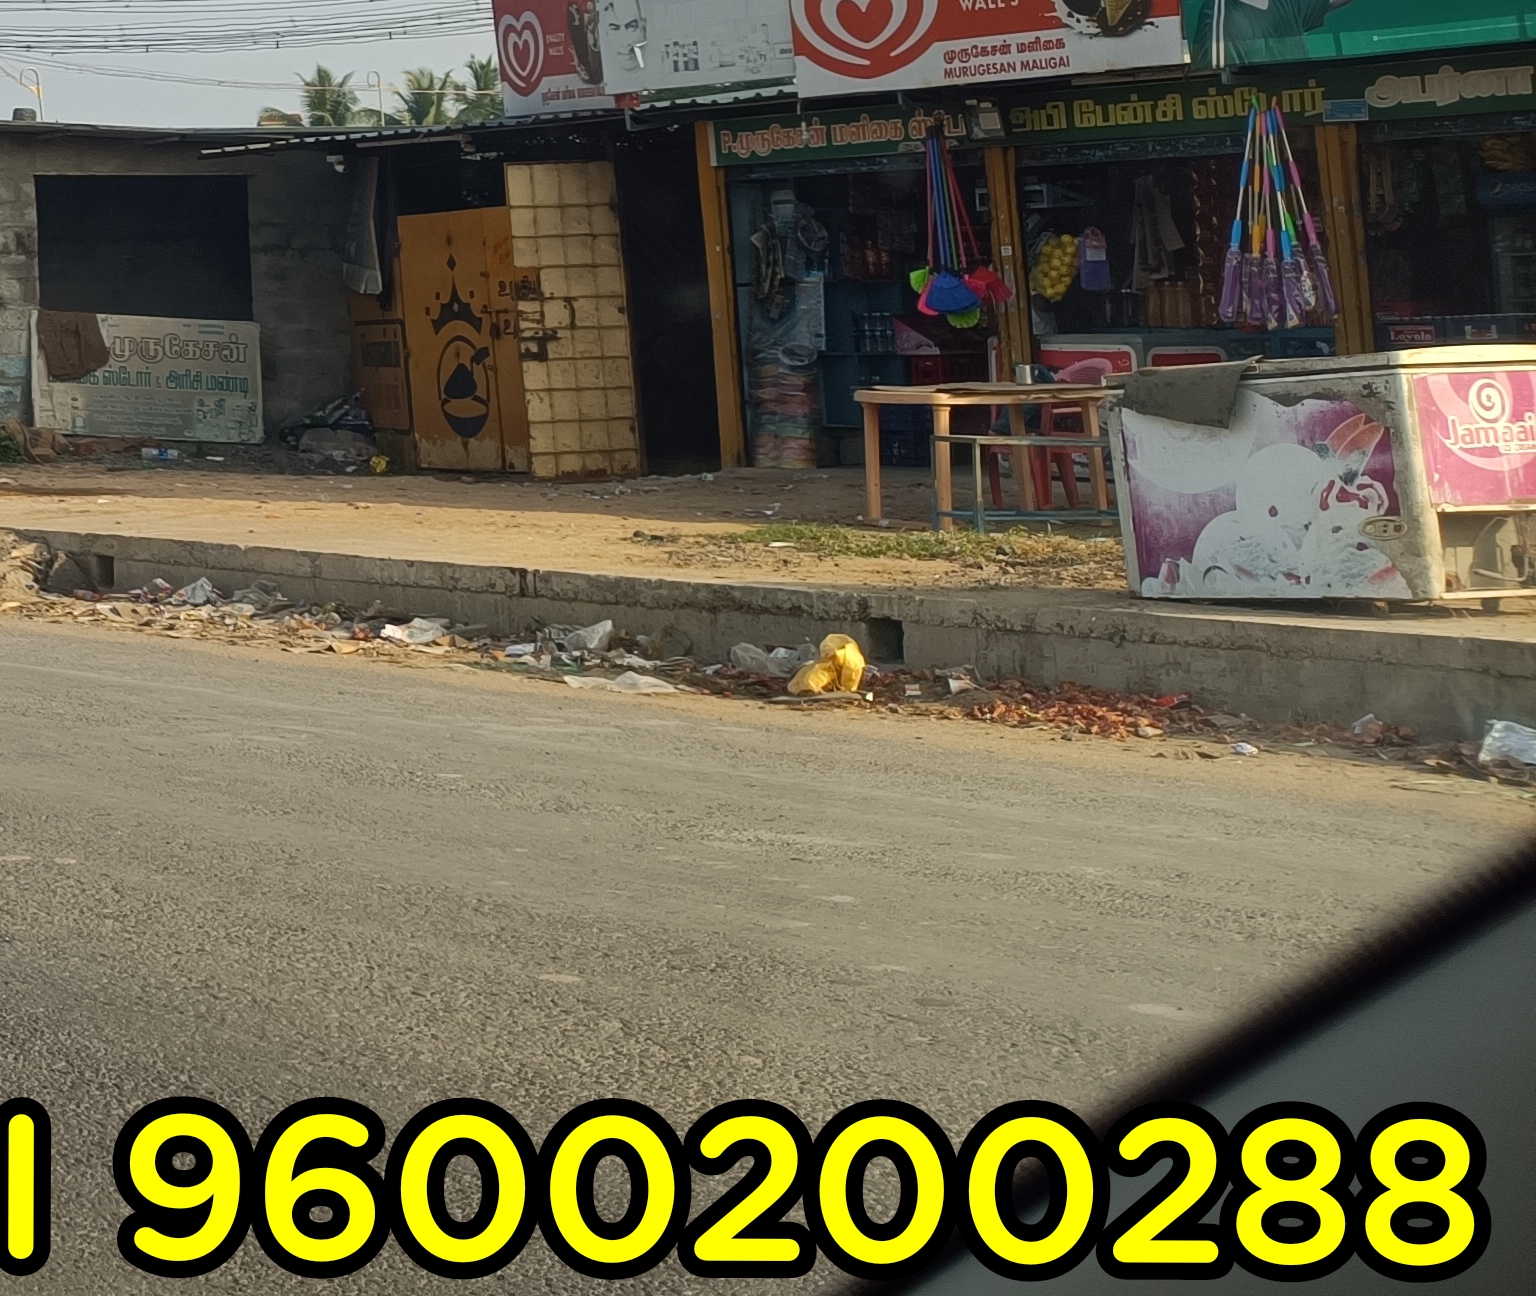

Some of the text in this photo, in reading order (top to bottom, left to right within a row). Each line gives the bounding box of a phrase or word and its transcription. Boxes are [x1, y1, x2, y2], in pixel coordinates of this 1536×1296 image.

[943, 36, 1066, 64] முருகேசன் மளிகை
[943, 55, 1070, 80] MURUGESAN MALIGAI
[1073, 92, 1183, 129] பேன்சி
[831, 114, 903, 145] மளிகை
[109, 332, 248, 364] முருகேசன்
